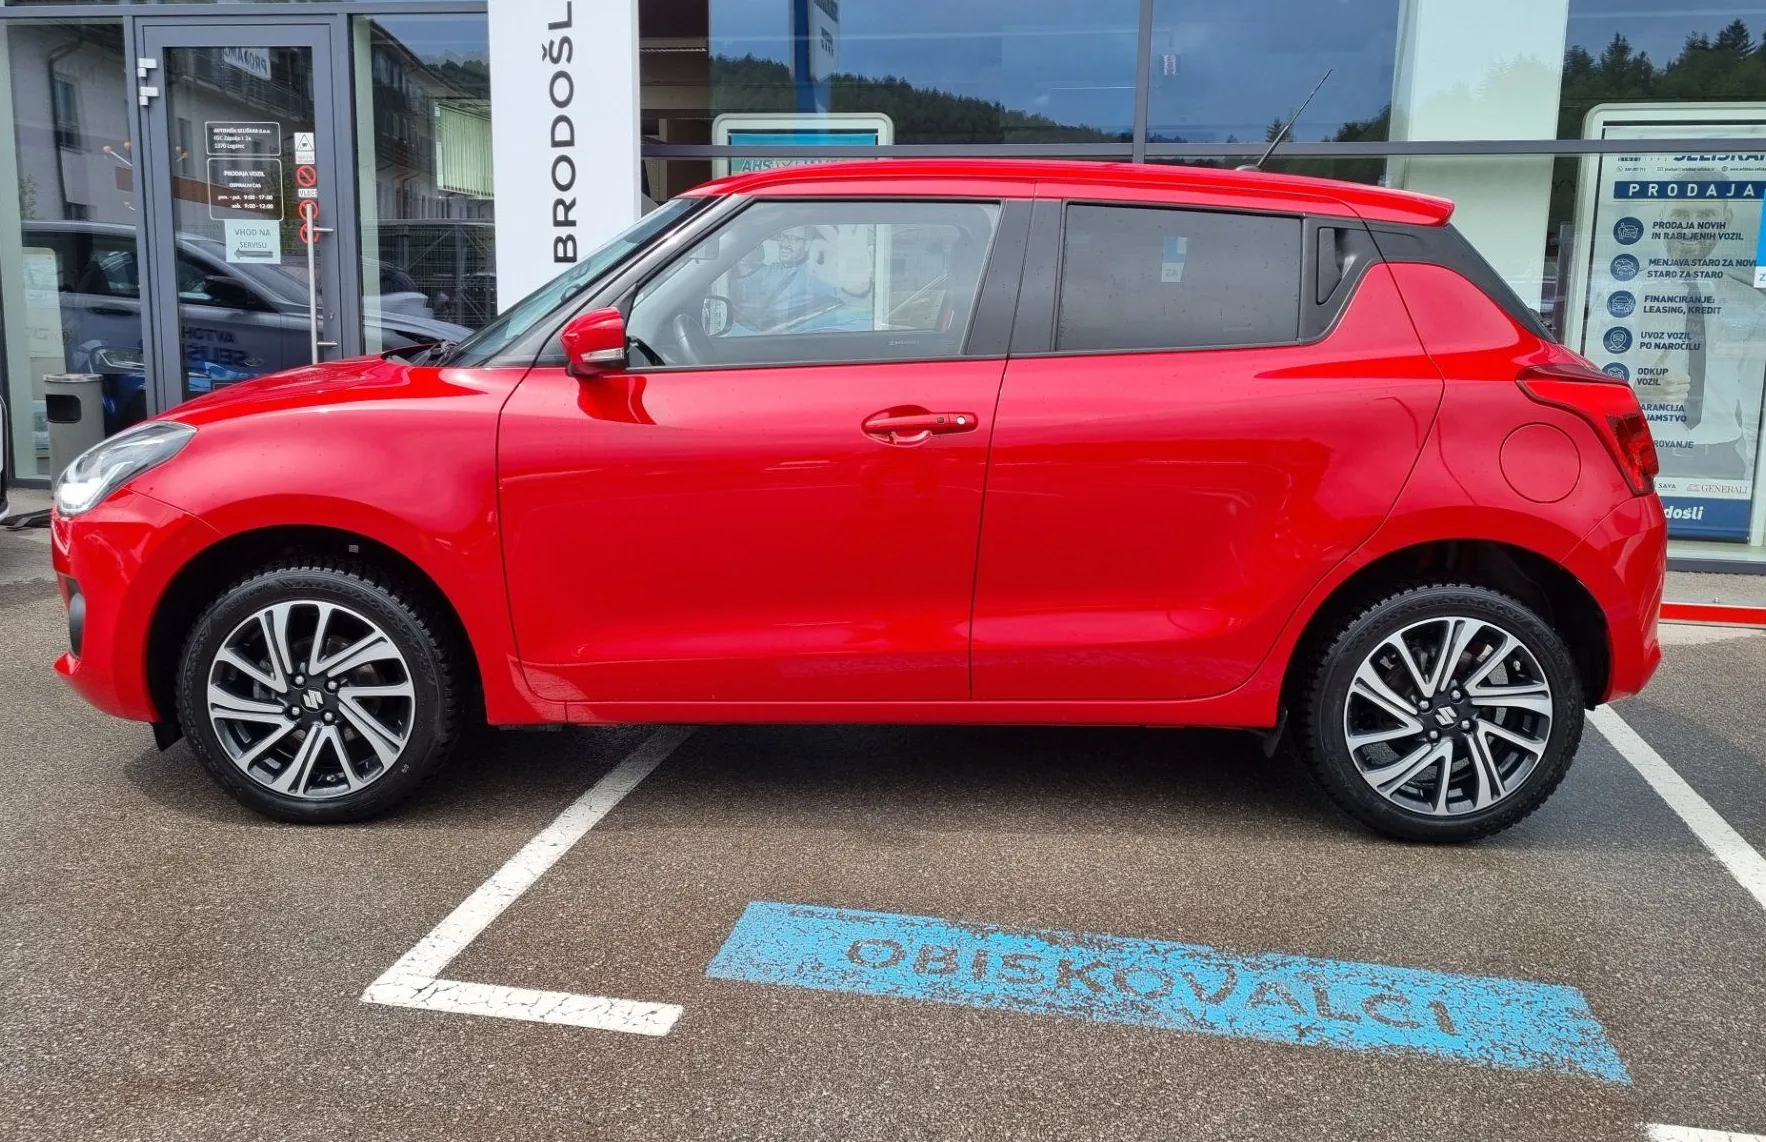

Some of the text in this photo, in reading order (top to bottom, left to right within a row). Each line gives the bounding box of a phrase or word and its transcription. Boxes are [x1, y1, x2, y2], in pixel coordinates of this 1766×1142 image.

[1628, 183, 1755, 197] PRODAJA
[1652, 221, 1727, 230] PRODAJA NOVIH
[1651, 232, 1744, 241] IN RABLJENIH VOZIL
[239, 241, 267, 249] SERVISU
[1648, 258, 1691, 267] MENJAVA
[1691, 258, 1721, 267] STARO
[1721, 258, 1734, 267] ZA
[1647, 270, 1724, 279] STARO ZA STARO
[1644, 295, 1716, 304] FINANCIRANJE:
[1643, 305, 1722, 315] LEASING, KREDIT
[1640, 331, 1692, 340] UVOZ VOZIL
[1639, 340, 1701, 351] PO NAROČILU
[1637, 367, 1669, 376] ODKUP
[1636, 378, 1661, 386] VOZIL
[1640, 403, 1685, 412] ARANCIJA
[1701, 484, 1748, 494] GENERALI
[848, 937, 1460, 1037] OBISKOVALCI
